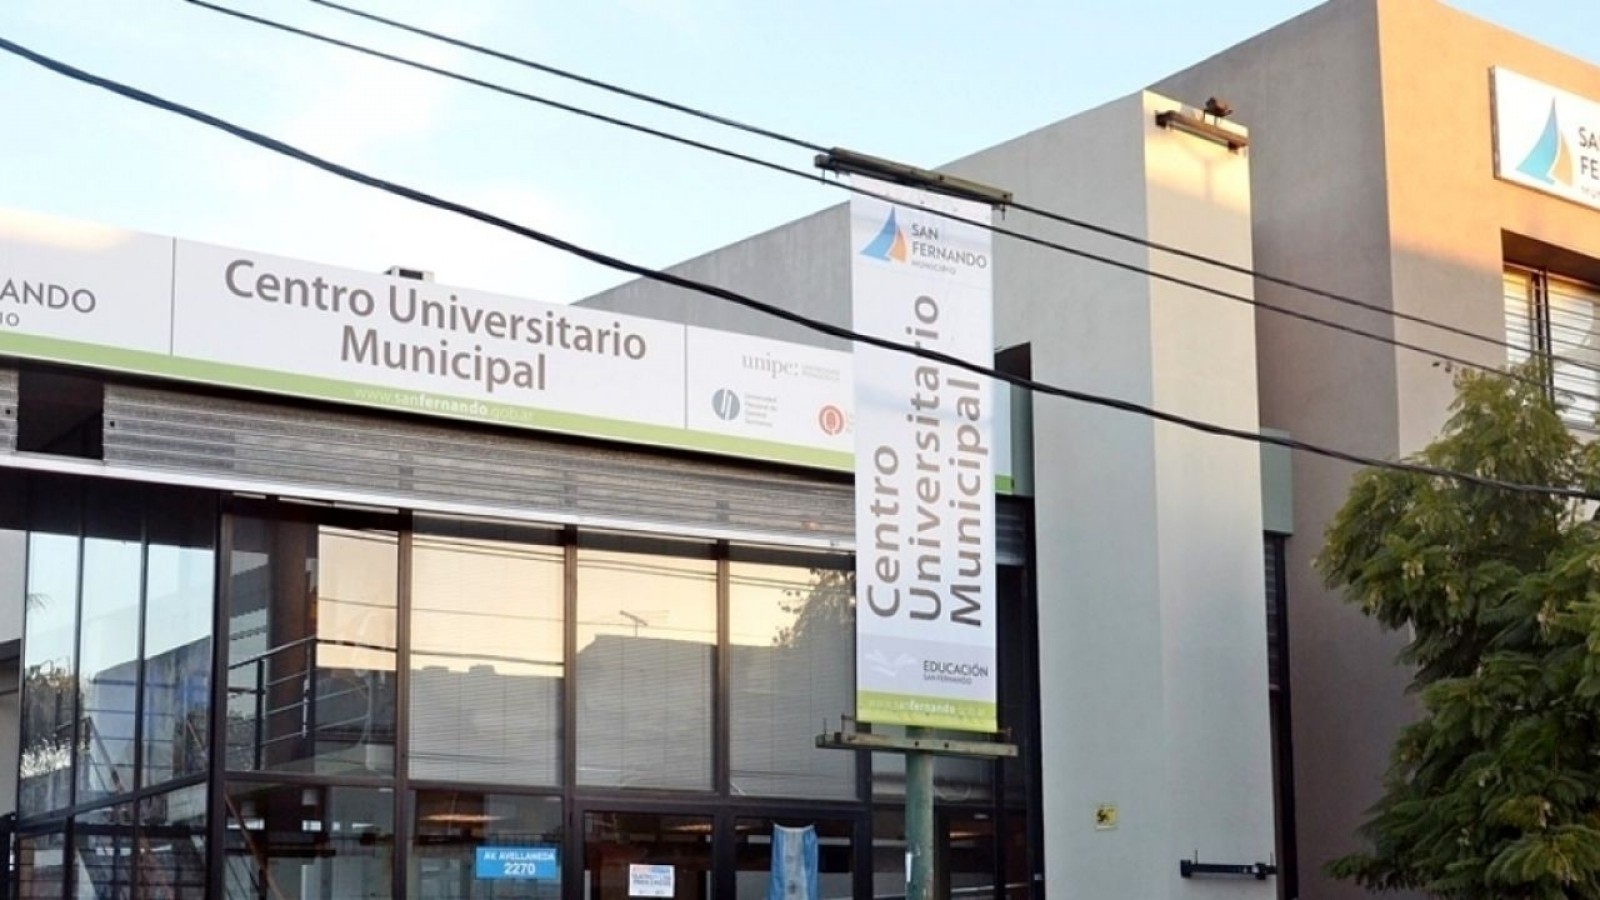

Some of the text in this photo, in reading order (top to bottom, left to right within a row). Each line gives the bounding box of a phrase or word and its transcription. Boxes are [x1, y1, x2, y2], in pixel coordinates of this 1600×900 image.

[911, 223, 939, 240] SAN
[911, 241, 988, 269] FERNANDO
[0, 277, 96, 314] ANDO
[224, 259, 647, 361] Centro Universitario
[340, 324, 547, 393] Municipal
[946, 378, 989, 629] Municipal
[866, 445, 901, 618] Centro
[504, 862, 536, 876] 2270
